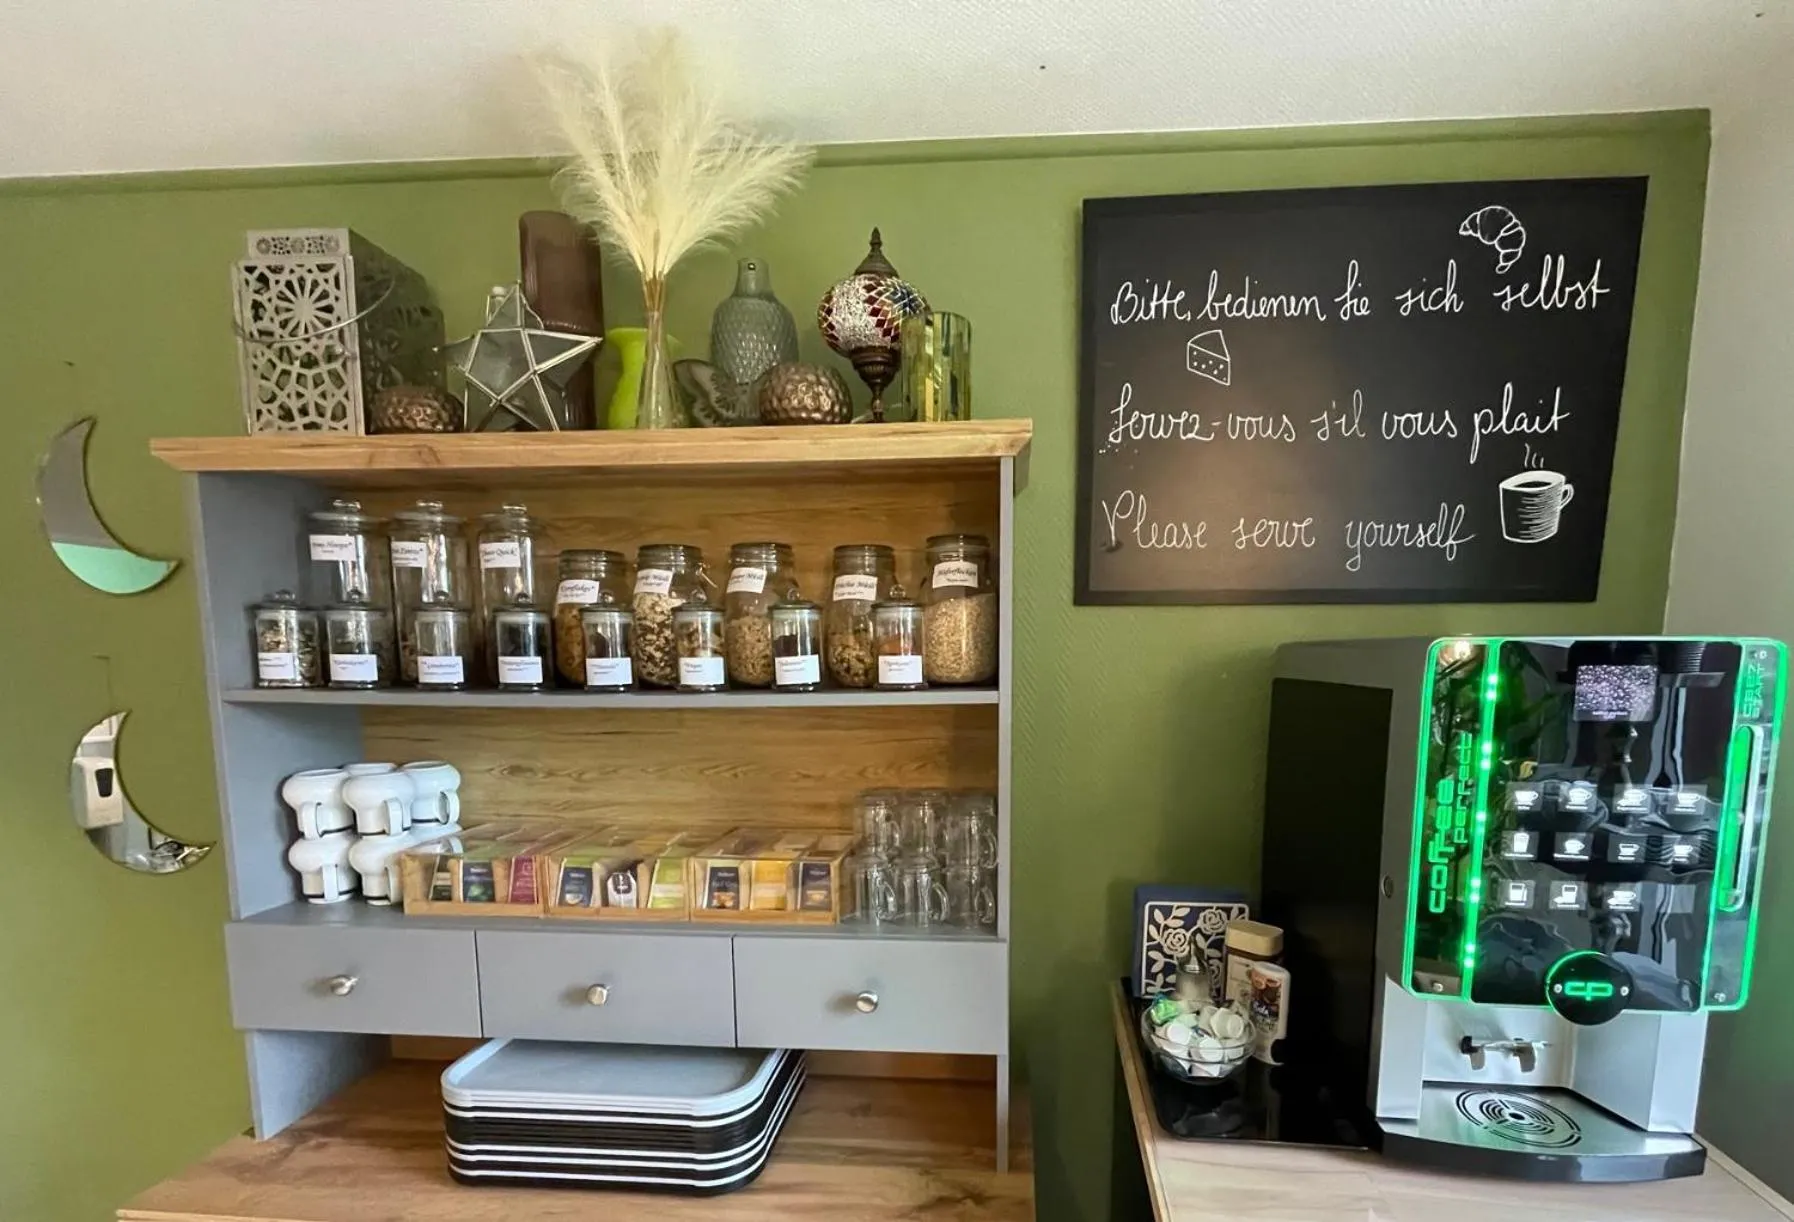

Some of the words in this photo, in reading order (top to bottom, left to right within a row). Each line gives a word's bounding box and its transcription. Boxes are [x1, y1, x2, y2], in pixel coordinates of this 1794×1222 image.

[1110, 278, 1191, 325] Bitte,
[1197, 269, 1327, 321] bedienen
[1333, 259, 1372, 321] Sie
[1395, 258, 1465, 316] sich
[1493, 254, 1611, 312] selbst
[1108, 383, 1297, 444] Servez-vous
[1309, 388, 1367, 441] s'il
[1381, 409, 1458, 440] vous
[1468, 380, 1571, 465] plait
[1101, 489, 1208, 549] Please
[1231, 516, 1317, 549] serve
[1344, 502, 1478, 571] yourself
[1453, 730, 1473, 844] perfect
[1428, 778, 1455, 914] coffee
